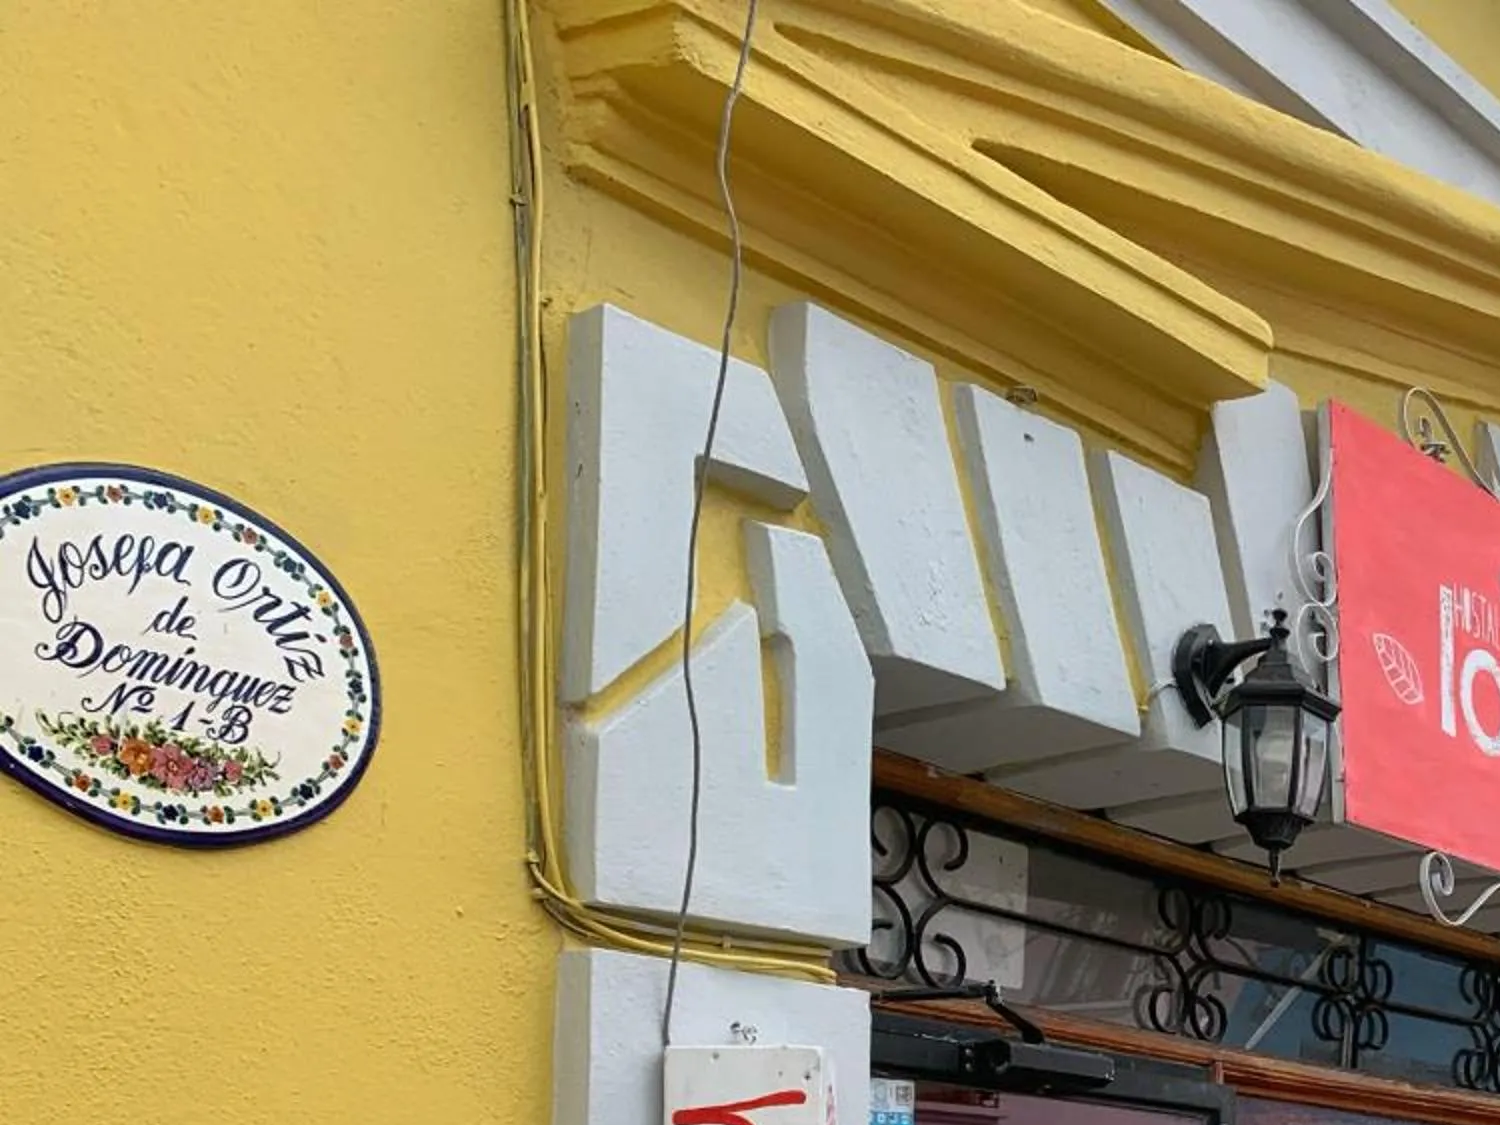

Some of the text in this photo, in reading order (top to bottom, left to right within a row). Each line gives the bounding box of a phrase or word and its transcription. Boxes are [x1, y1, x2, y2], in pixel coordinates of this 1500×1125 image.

[27, 533, 326, 683] Josefa Ortiz
[141, 596, 198, 641] de
